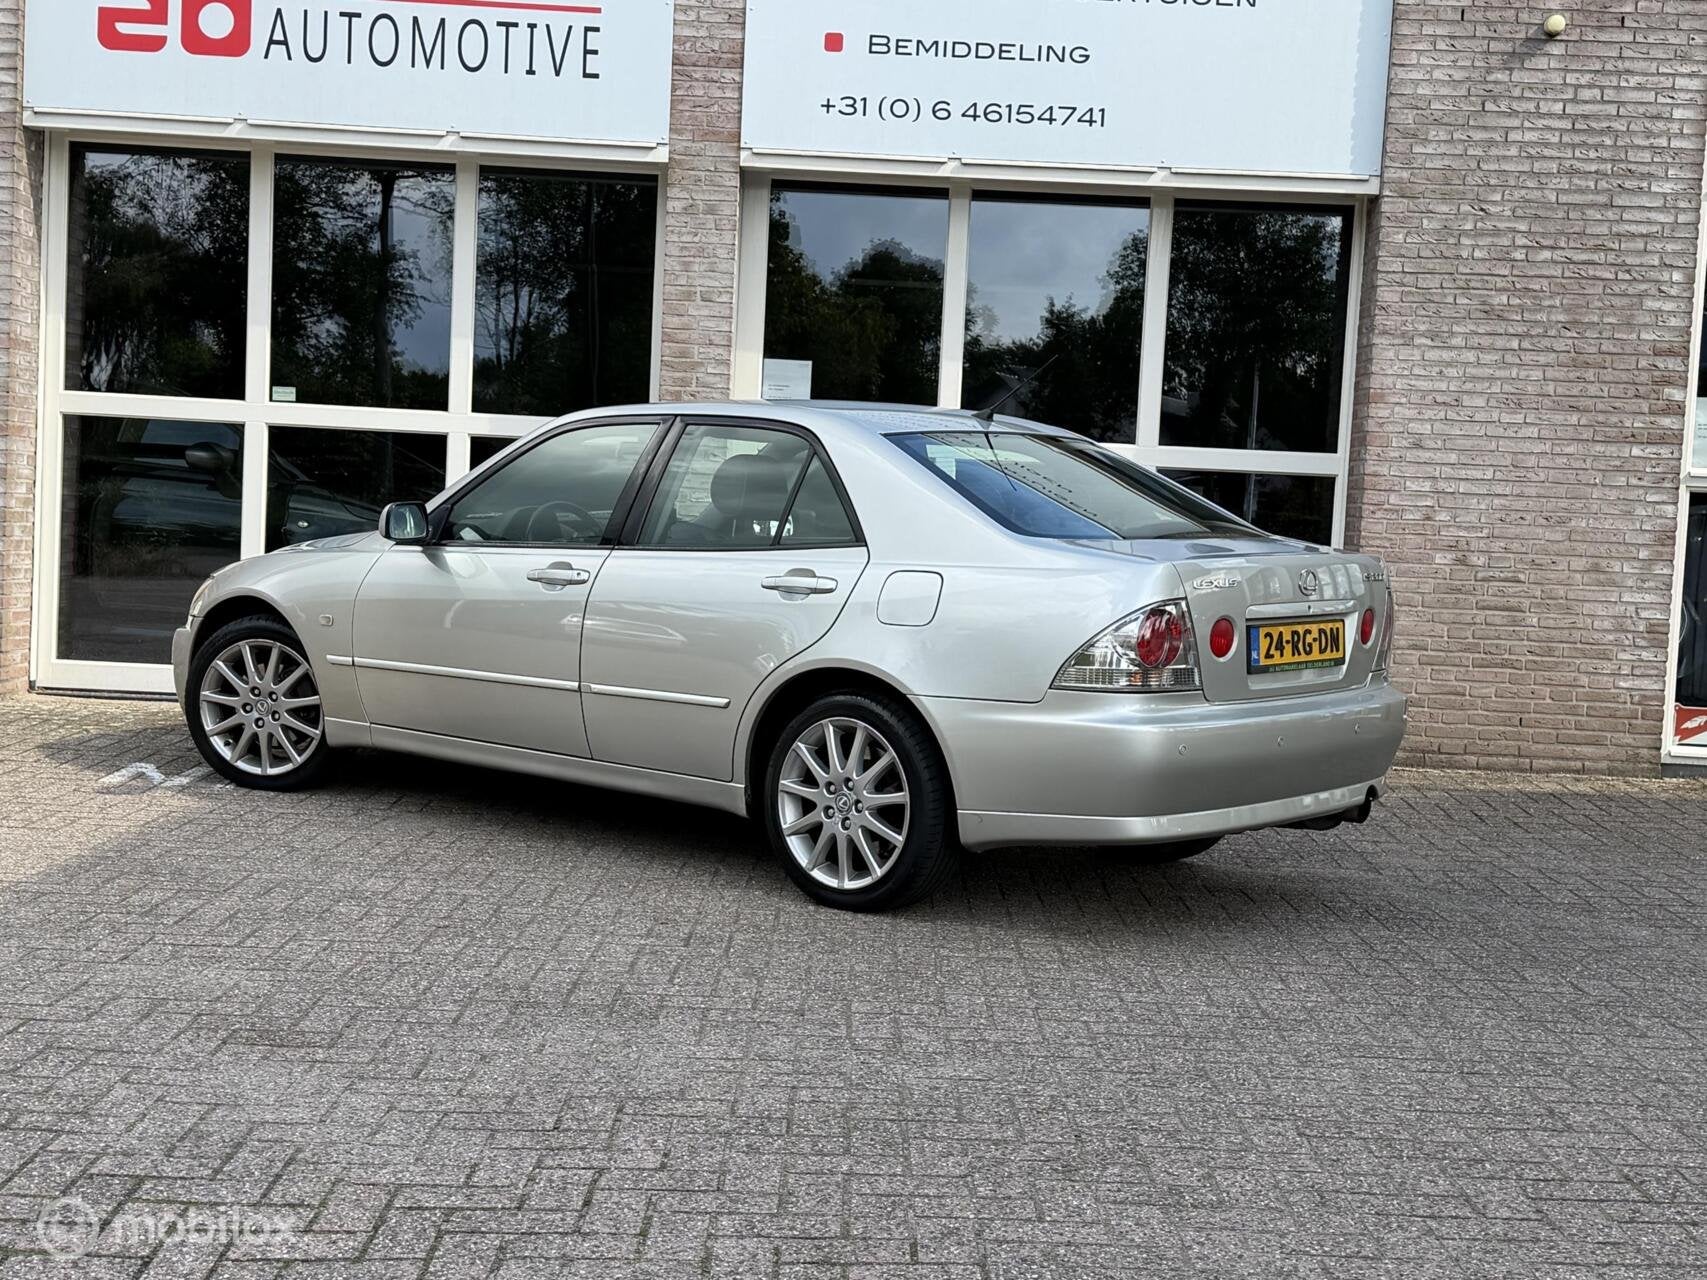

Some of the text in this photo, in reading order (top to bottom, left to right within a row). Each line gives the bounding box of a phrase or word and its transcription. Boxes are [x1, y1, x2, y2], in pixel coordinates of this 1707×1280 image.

[263, 7, 601, 79] AUTOMOTIVE
[820, 96, 1106, 128] +31 (0) 6 46154741
[1192, 577, 1241, 589] LEXUS
[1264, 627, 1340, 660] 24-RG-DN
